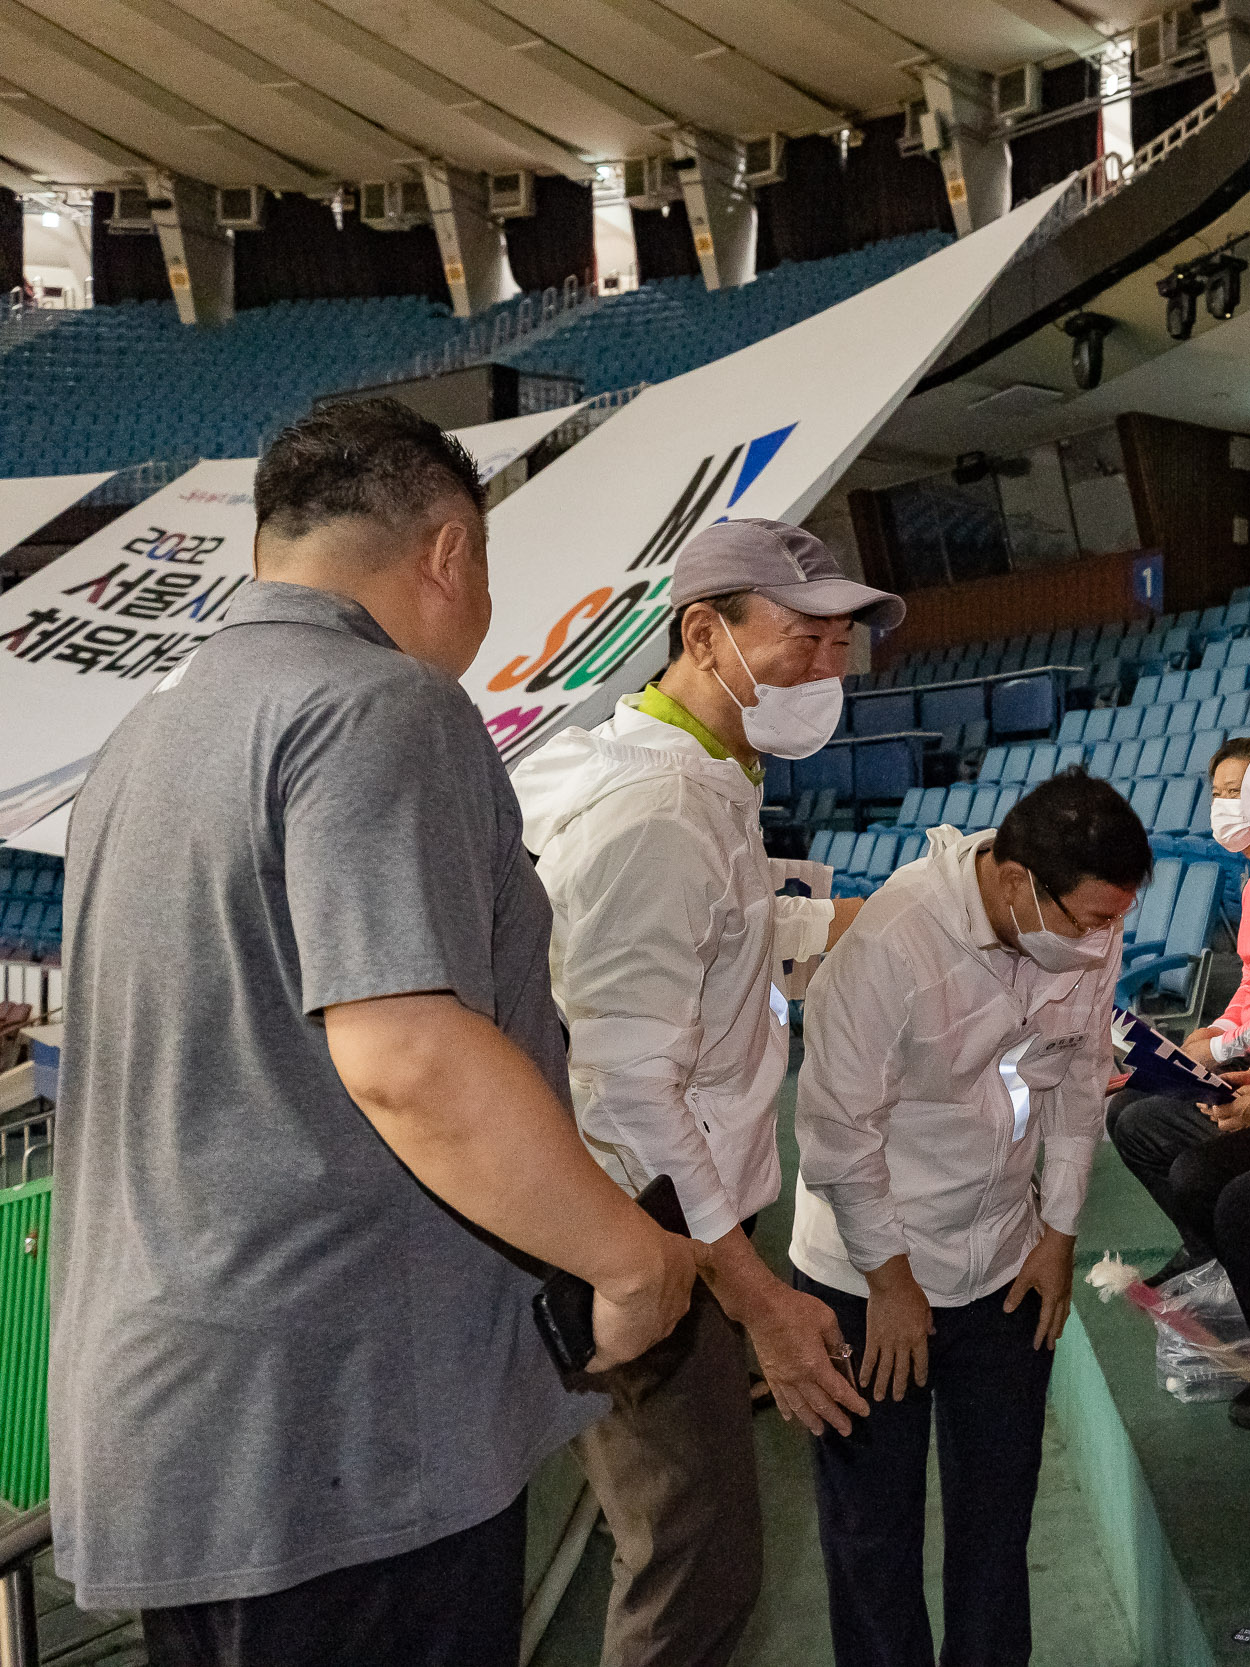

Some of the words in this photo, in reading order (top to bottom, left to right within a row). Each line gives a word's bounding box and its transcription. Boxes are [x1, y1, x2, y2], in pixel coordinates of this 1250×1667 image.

[121, 526, 226, 565] 2022
[61, 562, 250, 622] 서울시
[1142, 566, 1152, 599] 1
